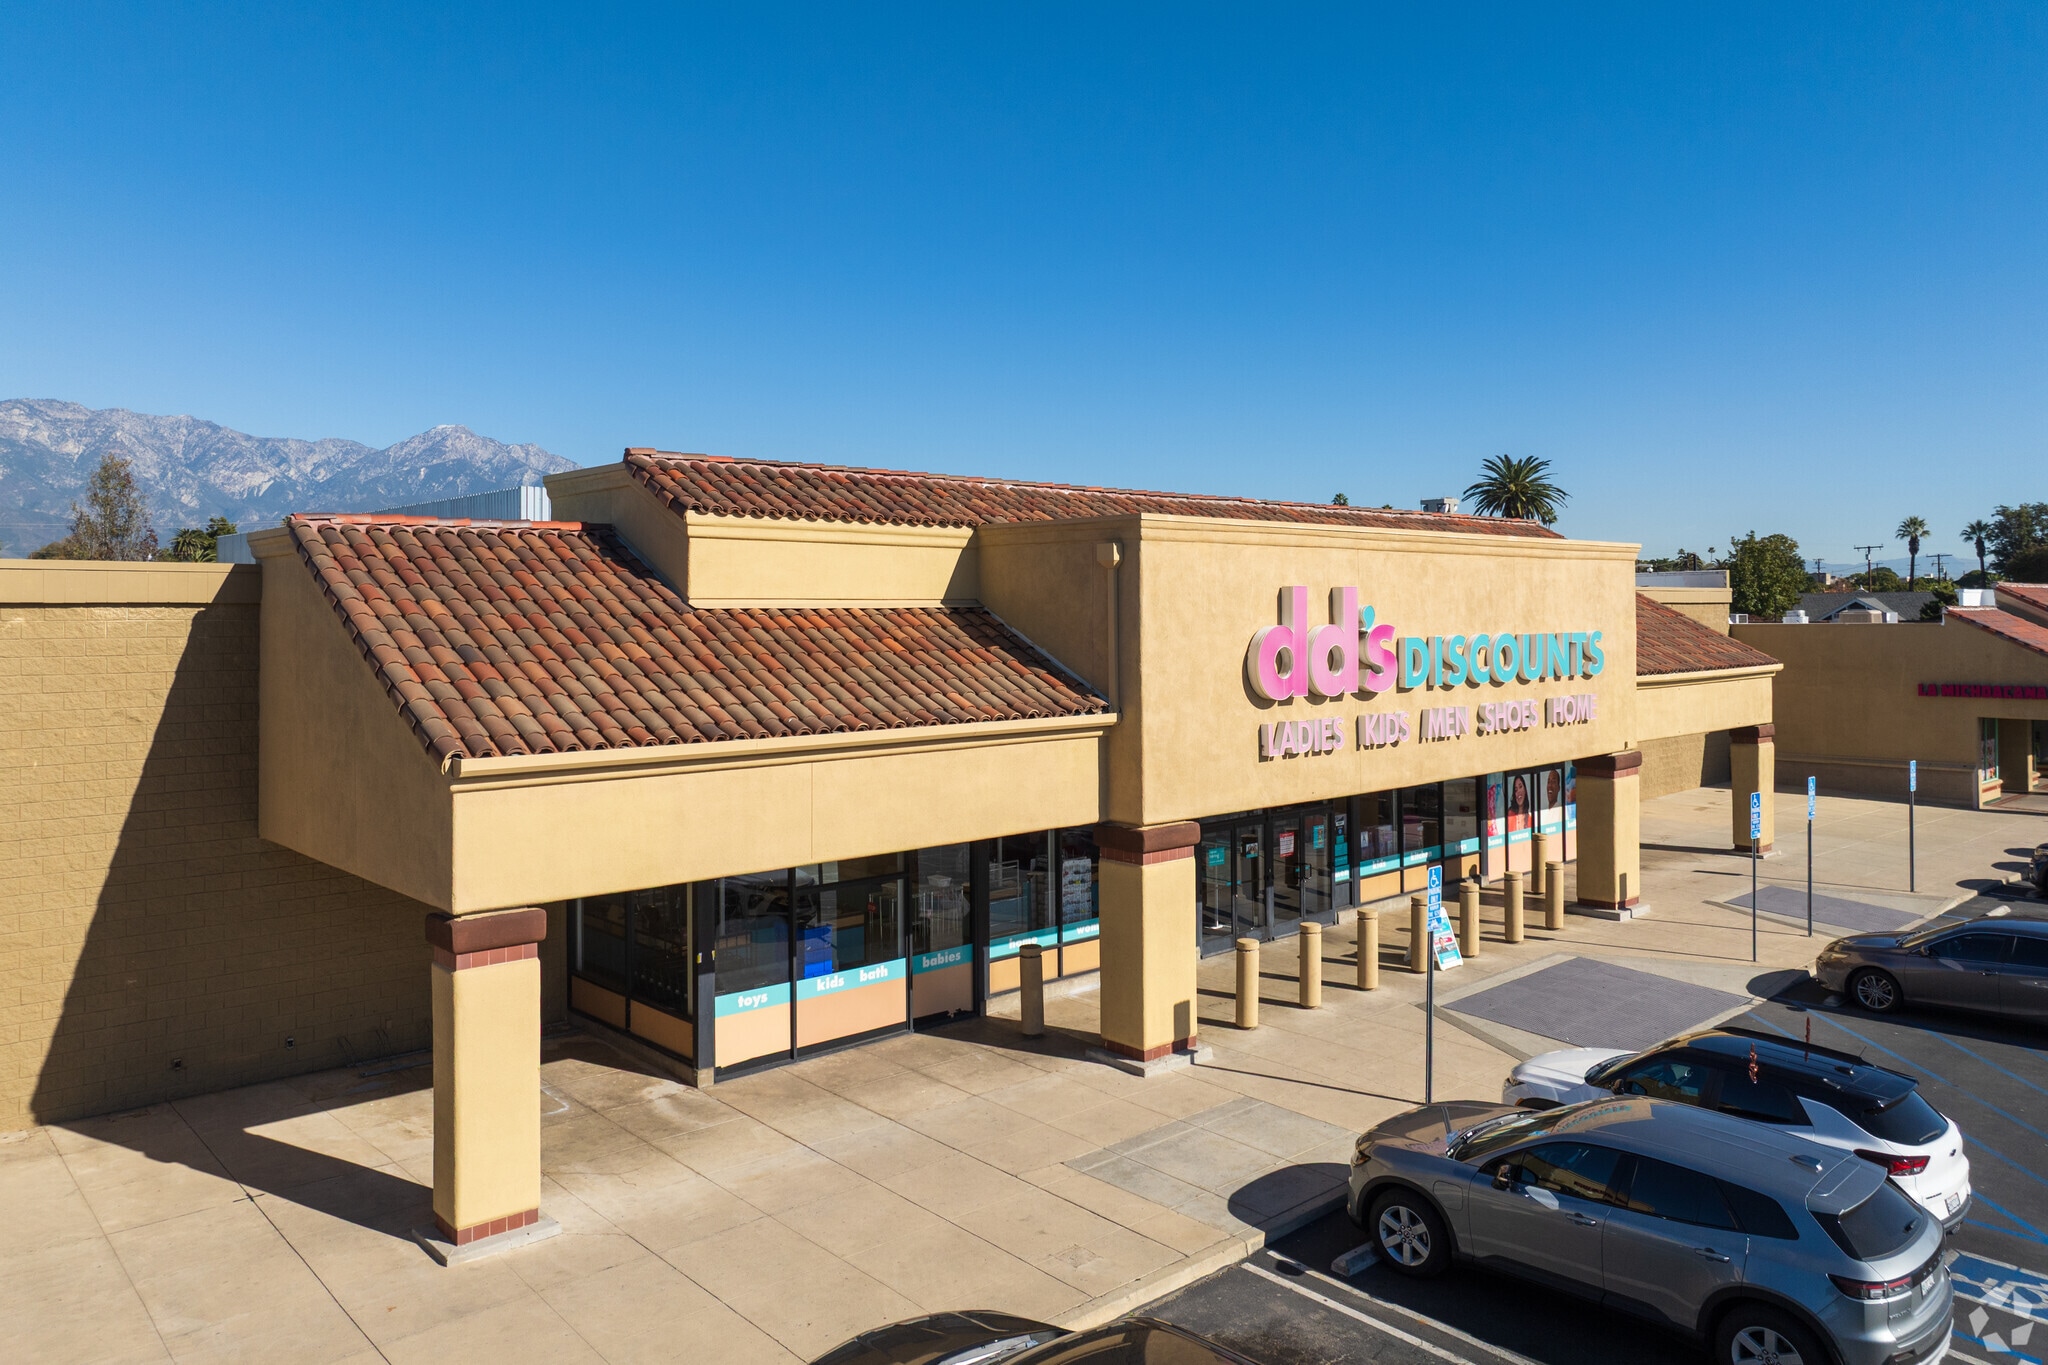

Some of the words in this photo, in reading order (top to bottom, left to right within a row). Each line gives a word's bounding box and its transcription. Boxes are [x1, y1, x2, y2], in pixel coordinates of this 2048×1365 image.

[1248, 585, 1399, 701] dd's
[1400, 630, 1605, 689] DISCOUNTS
[1917, 683, 1938, 697] LA
[1261, 716, 1345, 757] LADIES
[1358, 711, 1411, 746] KIDS
[1422, 706, 1470, 739] MEN
[1478, 699, 1539, 732] SHOES
[1545, 694, 1598, 725] HOME
[922, 950, 962, 969] babies
[816, 975, 845, 992] kids
[859, 964, 889, 983] bath
[737, 991, 769, 1009] toys
